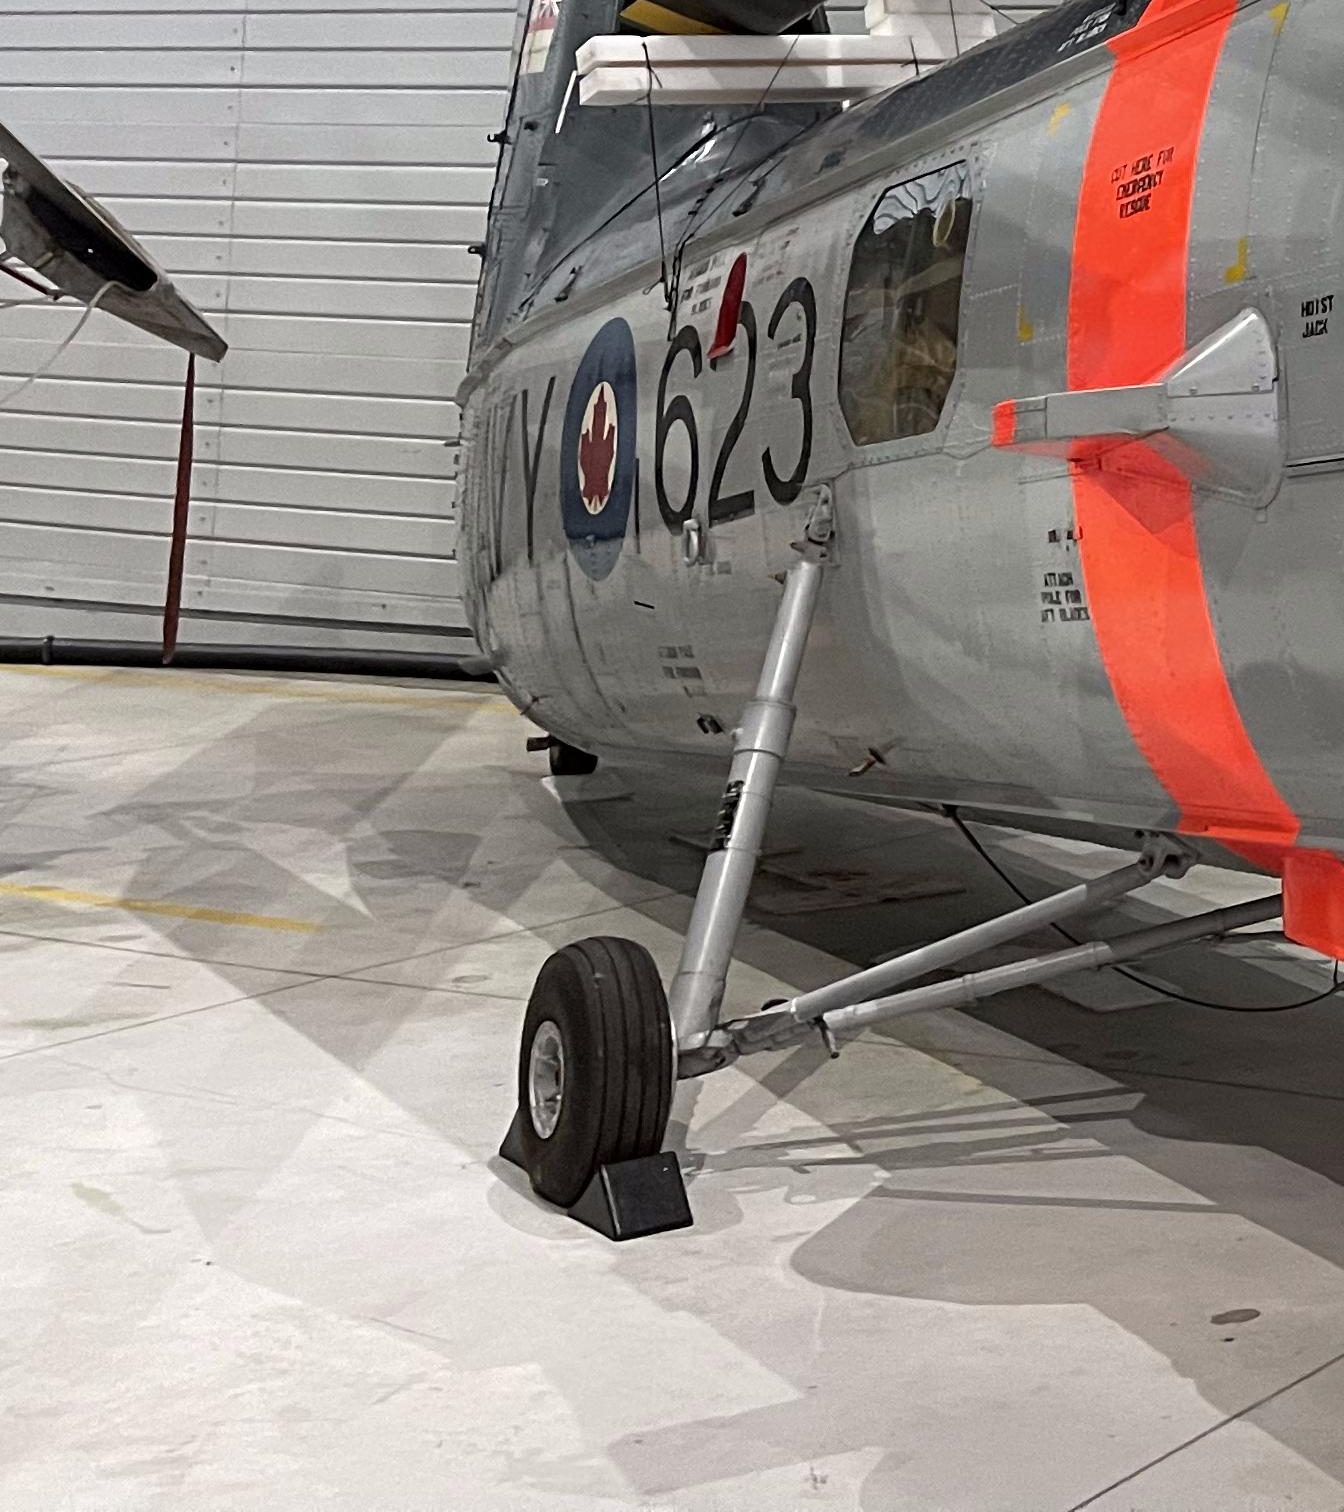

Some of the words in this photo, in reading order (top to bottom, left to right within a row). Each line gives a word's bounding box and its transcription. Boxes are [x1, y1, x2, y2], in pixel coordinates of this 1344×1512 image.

[1301, 294, 1335, 318] HOIST
[1302, 318, 1329, 338] JACK
[655, 276, 817, 536] 623
